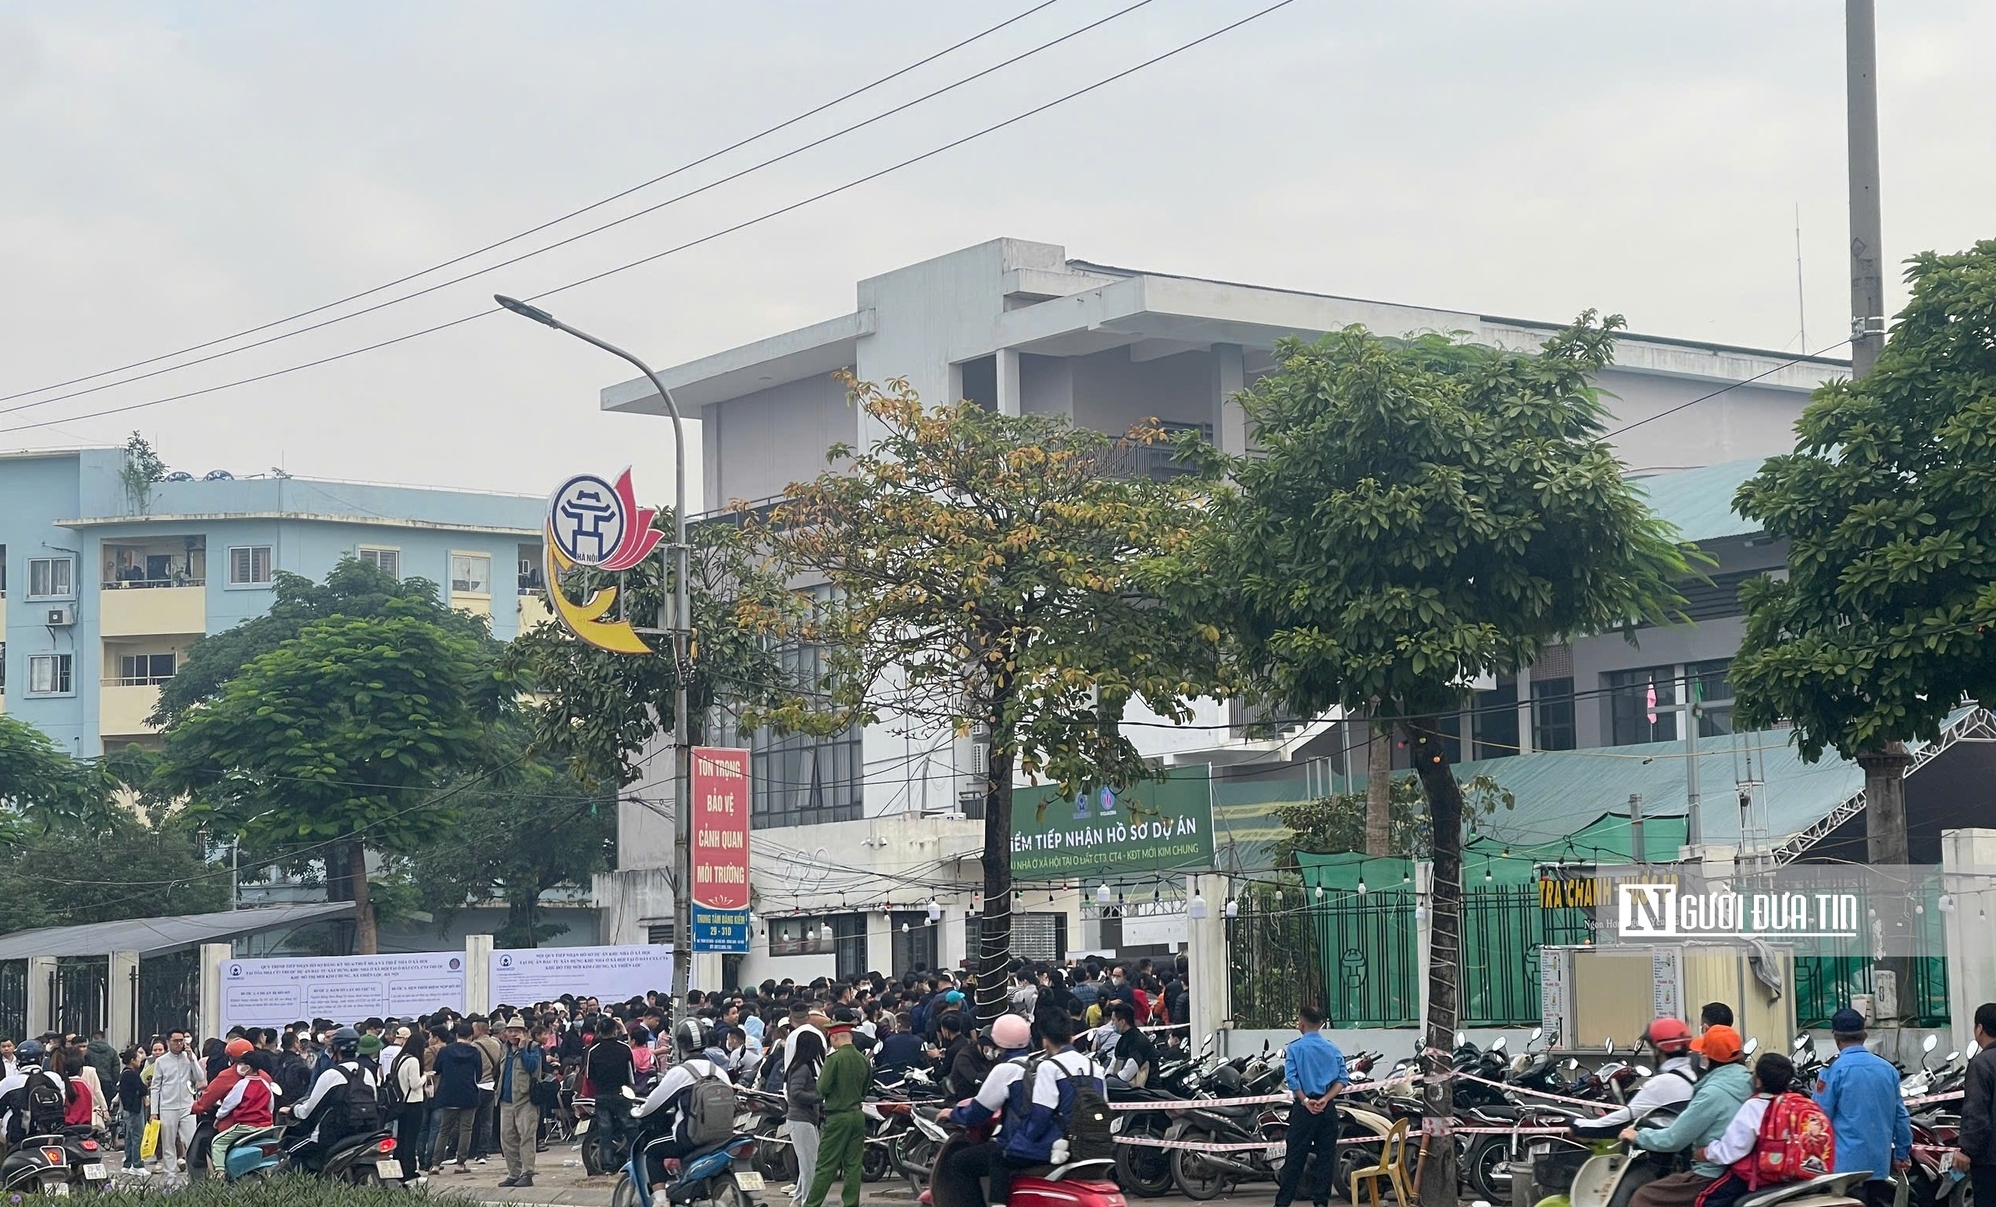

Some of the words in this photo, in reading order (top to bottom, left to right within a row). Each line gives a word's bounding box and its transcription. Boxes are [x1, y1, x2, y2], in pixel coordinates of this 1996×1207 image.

[576, 551, 586, 562] HÀ
[586, 553, 598, 564] NỘI
[698, 756, 714, 776] TÔN
[715, 760, 742, 782] TRỌNG,
[707, 787, 722, 812] BẢO
[724, 792, 734, 816] VỆ
[698, 822, 720, 848] CẢNH
[722, 830, 743, 850] QUAN
[1010, 830, 1032, 852] IỂM
[1035, 828, 1062, 850] TIẾP
[1065, 826, 1102, 848] NHẬN
[1107, 821, 1126, 843] HỒ
[1130, 822, 1148, 840] SƠ
[1152, 821, 1174, 840] DỰ
[1176, 815, 1196, 835] ÁN
[1017, 858, 1031, 870] NHÀ
[1049, 856, 1062, 868] HỘI
[1062, 856, 1072, 868] TẠI
[1109, 852, 1121, 862] CT4
[1127, 850, 1140, 860] KĐT
[1142, 846, 1157, 858] MỚI
[1158, 848, 1171, 857] KIM
[1172, 844, 1199, 855] CHUNG
[697, 862, 712, 883] MÔI
[714, 861, 744, 884] TRƯỜNG
[1567, 877, 1612, 907] CHANH
[710, 926, 717, 936] 29
